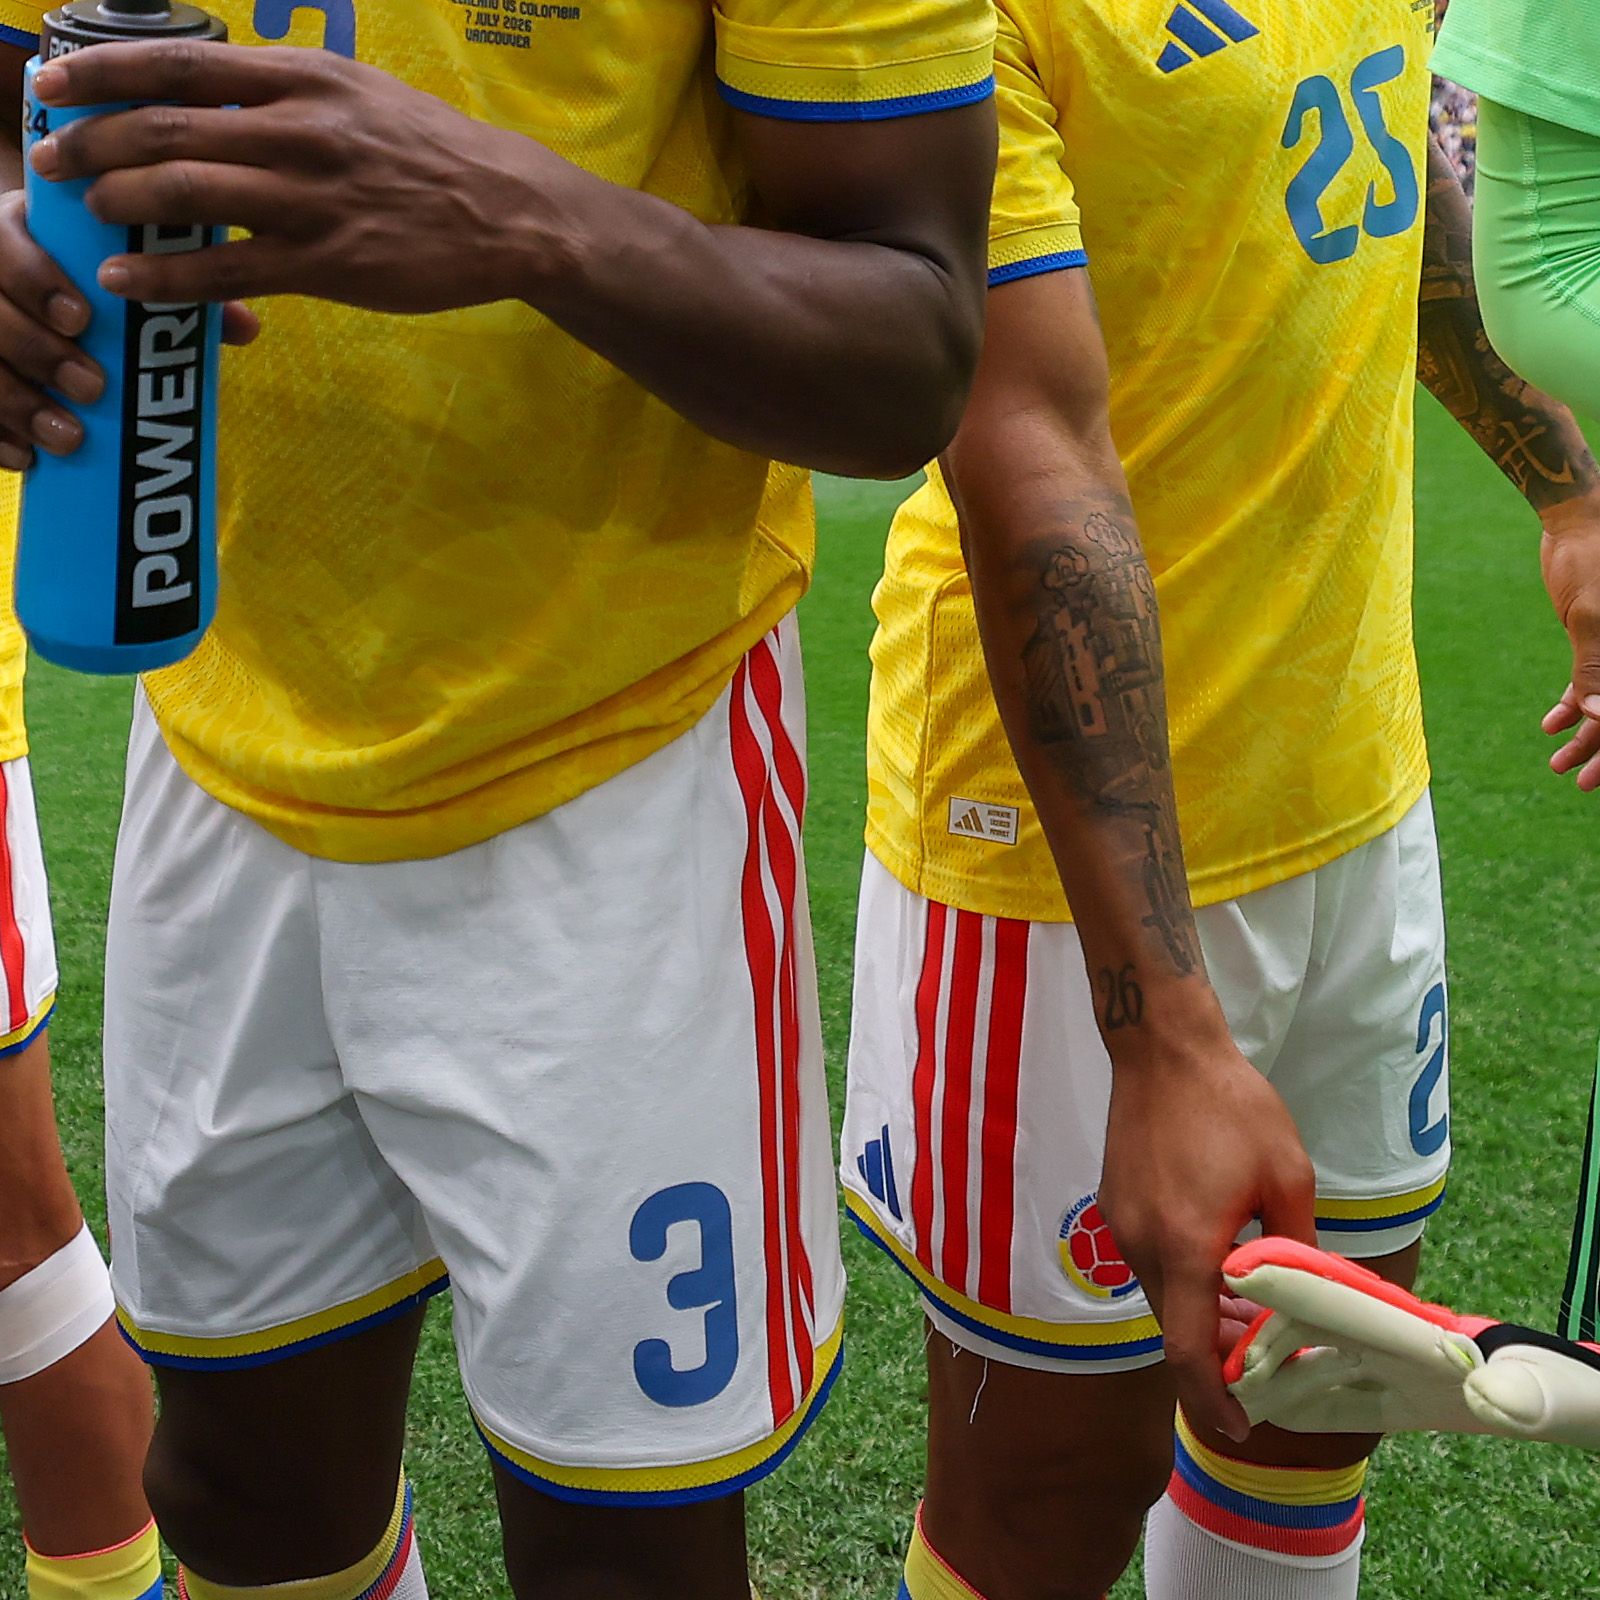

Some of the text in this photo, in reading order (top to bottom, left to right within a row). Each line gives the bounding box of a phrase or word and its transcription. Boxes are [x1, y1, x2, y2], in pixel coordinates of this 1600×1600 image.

[519, 1, 581, 20] COLOMBIA
[475, 12, 499, 27] JULY
[503, 16, 532, 33] 2026
[465, 27, 531, 48] VANCOUVER
[1280, 43, 1419, 265] 25
[629, 1181, 739, 1408] 3
